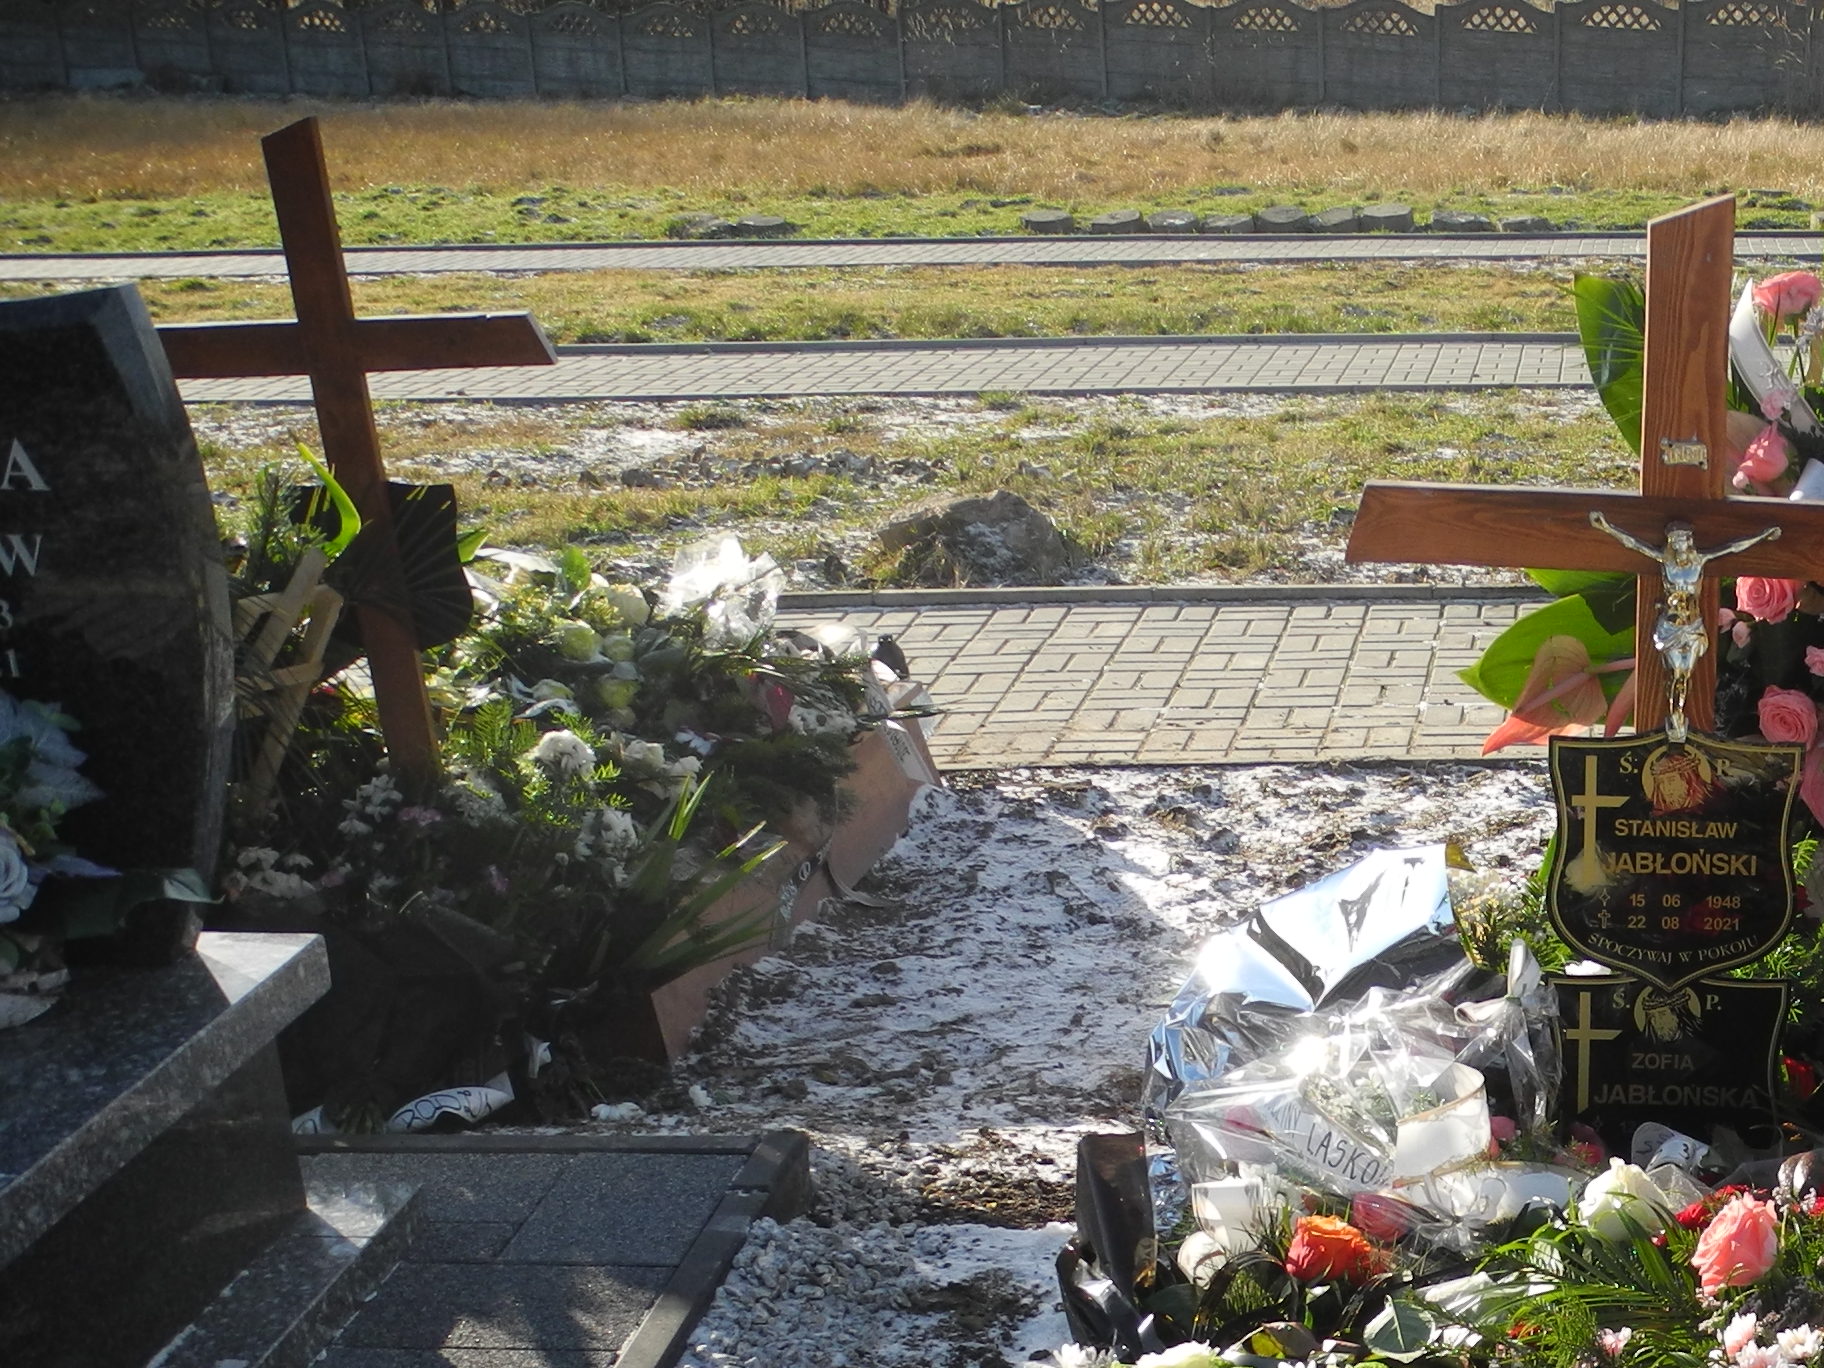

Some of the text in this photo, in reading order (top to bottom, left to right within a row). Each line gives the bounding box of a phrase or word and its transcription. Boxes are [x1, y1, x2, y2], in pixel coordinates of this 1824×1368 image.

[1614, 819, 1738, 839] STANISŁAW
[1606, 849, 1757, 876] JABŁOŃSKI
[1629, 894, 1741, 909] 15 06 1948
[1627, 915, 1740, 931] 22 08 2021
[1588, 932, 1758, 965] SPOCZYWAJ W POKOJU
[1613, 987, 1722, 1011] Ś. P.
[1631, 1053, 1695, 1071] ZOFIA
[1593, 1082, 1759, 1108] JABŁOŃSKA
